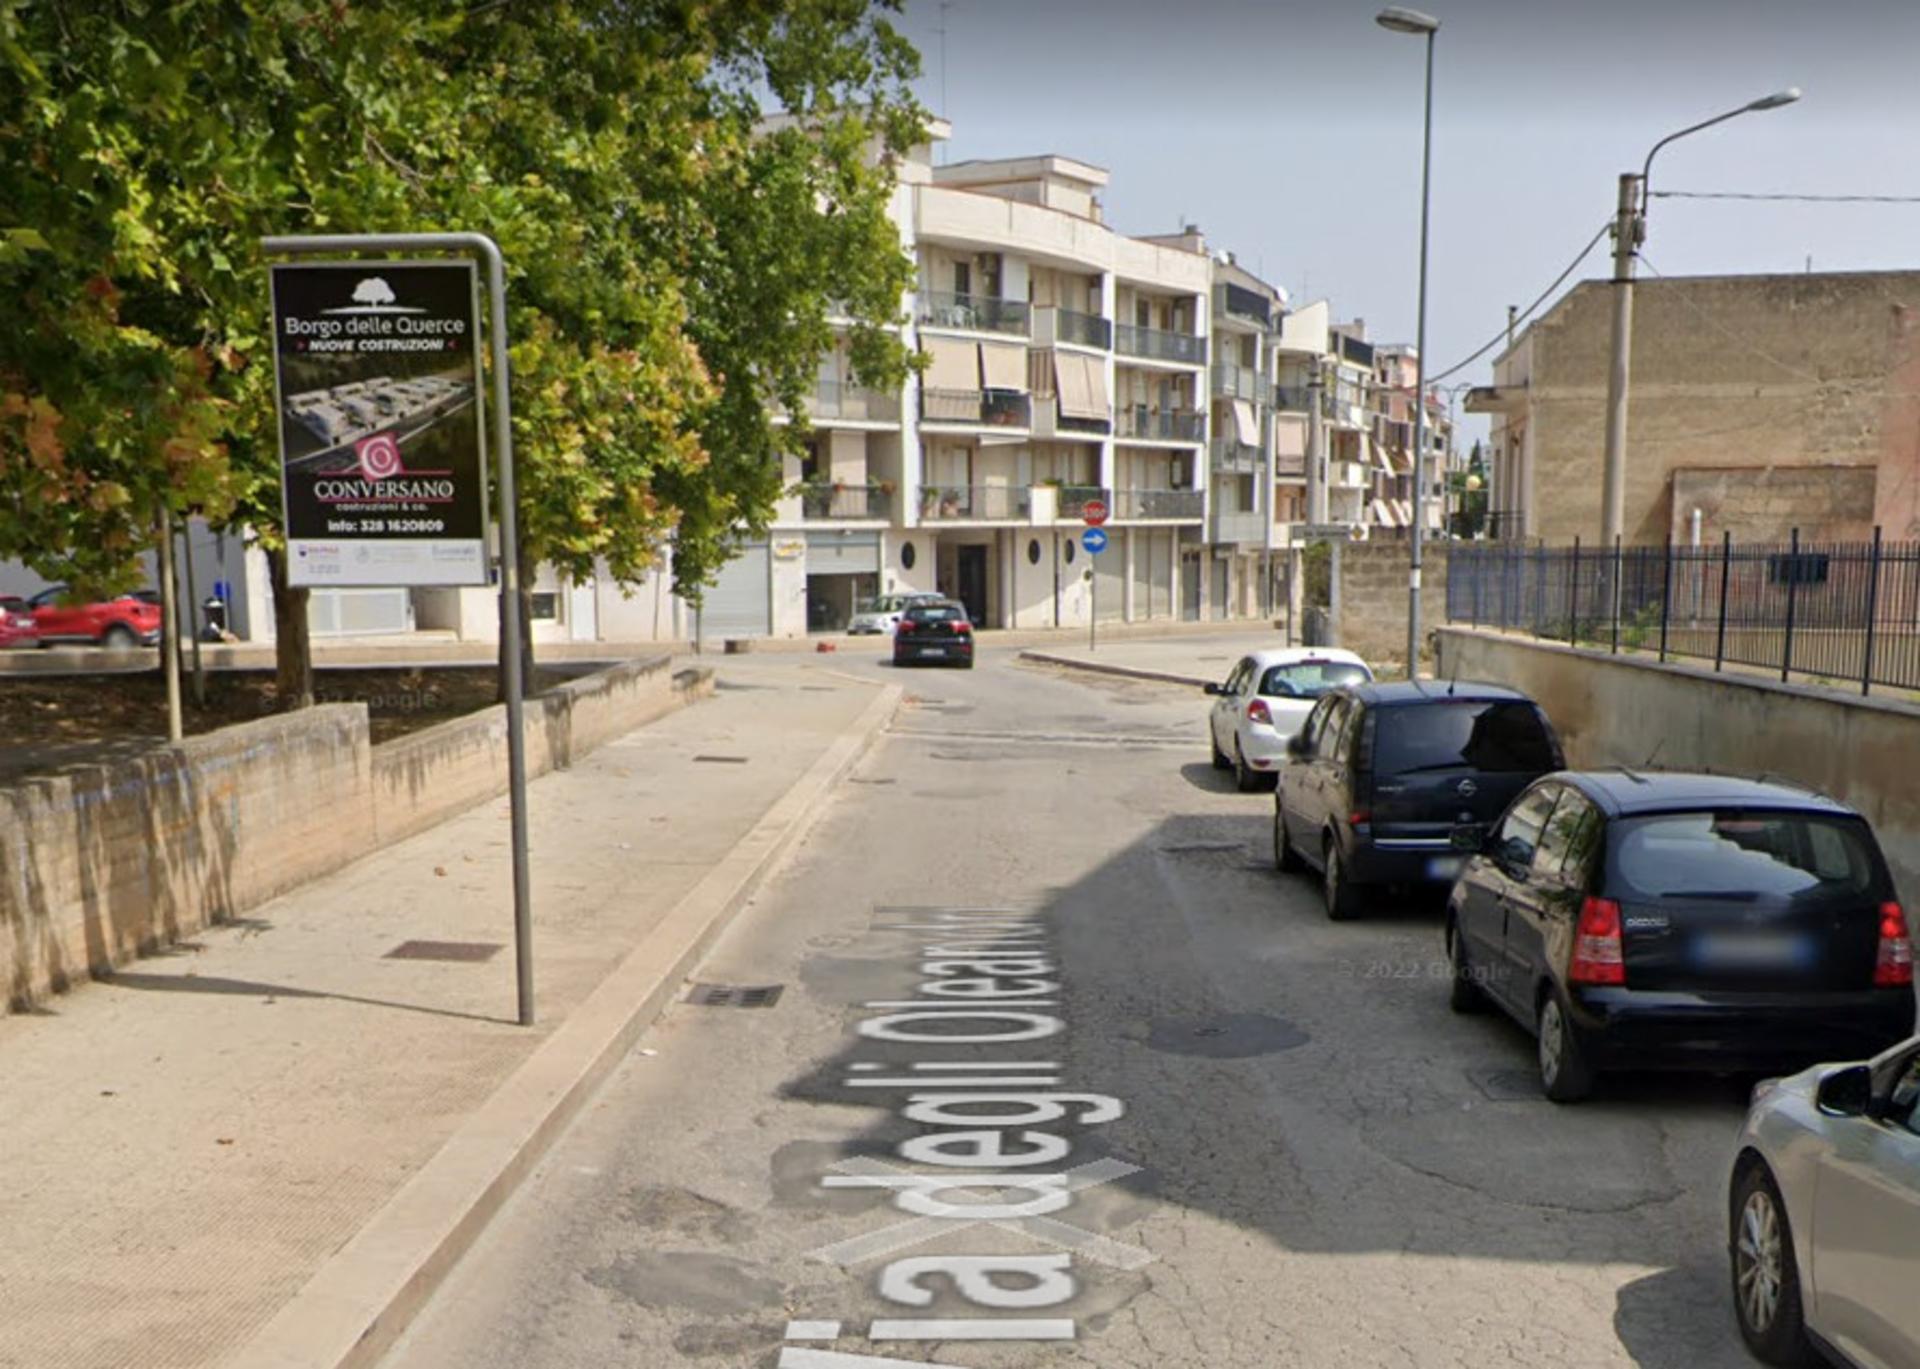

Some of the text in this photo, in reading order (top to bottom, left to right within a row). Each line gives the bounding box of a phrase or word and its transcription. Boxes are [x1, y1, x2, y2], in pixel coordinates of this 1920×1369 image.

[285, 316, 465, 338] Borgo delle Querce
[308, 339, 444, 351] NUOVE COSTRUZIONI
[313, 481, 454, 499] CONVERSANO
